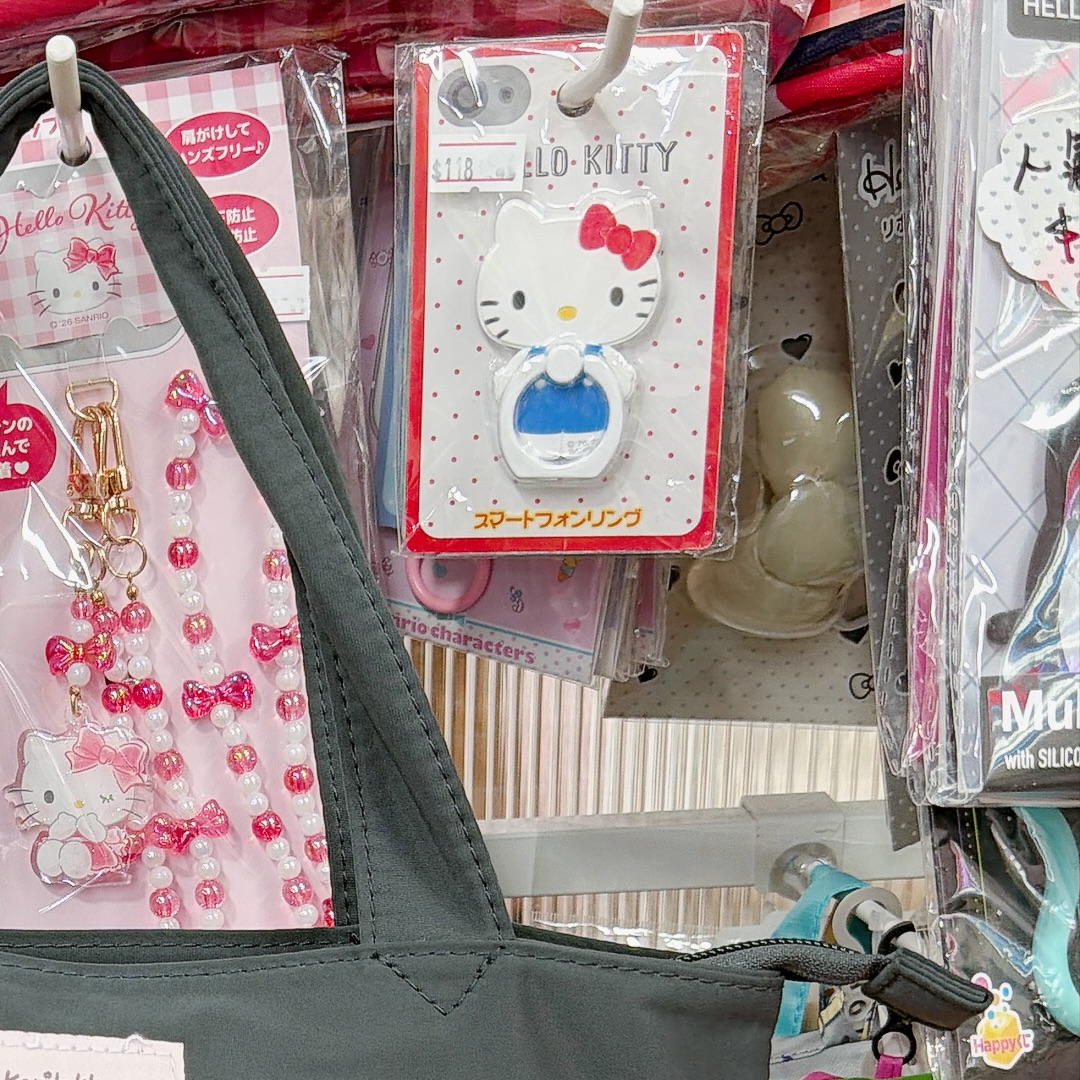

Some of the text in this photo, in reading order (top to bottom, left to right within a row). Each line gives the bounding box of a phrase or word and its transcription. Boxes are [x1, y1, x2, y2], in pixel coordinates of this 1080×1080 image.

[180, 122, 250, 147] 肩がけして
[583, 140, 678, 175] KITTY
[74, 311, 109, 325] SANRIO
[473, 508, 643, 530] スマートフォンリング
[430, 625, 536, 664] characters
[1001, 689, 1080, 732] Mu
[1004, 748, 1035, 769] with
